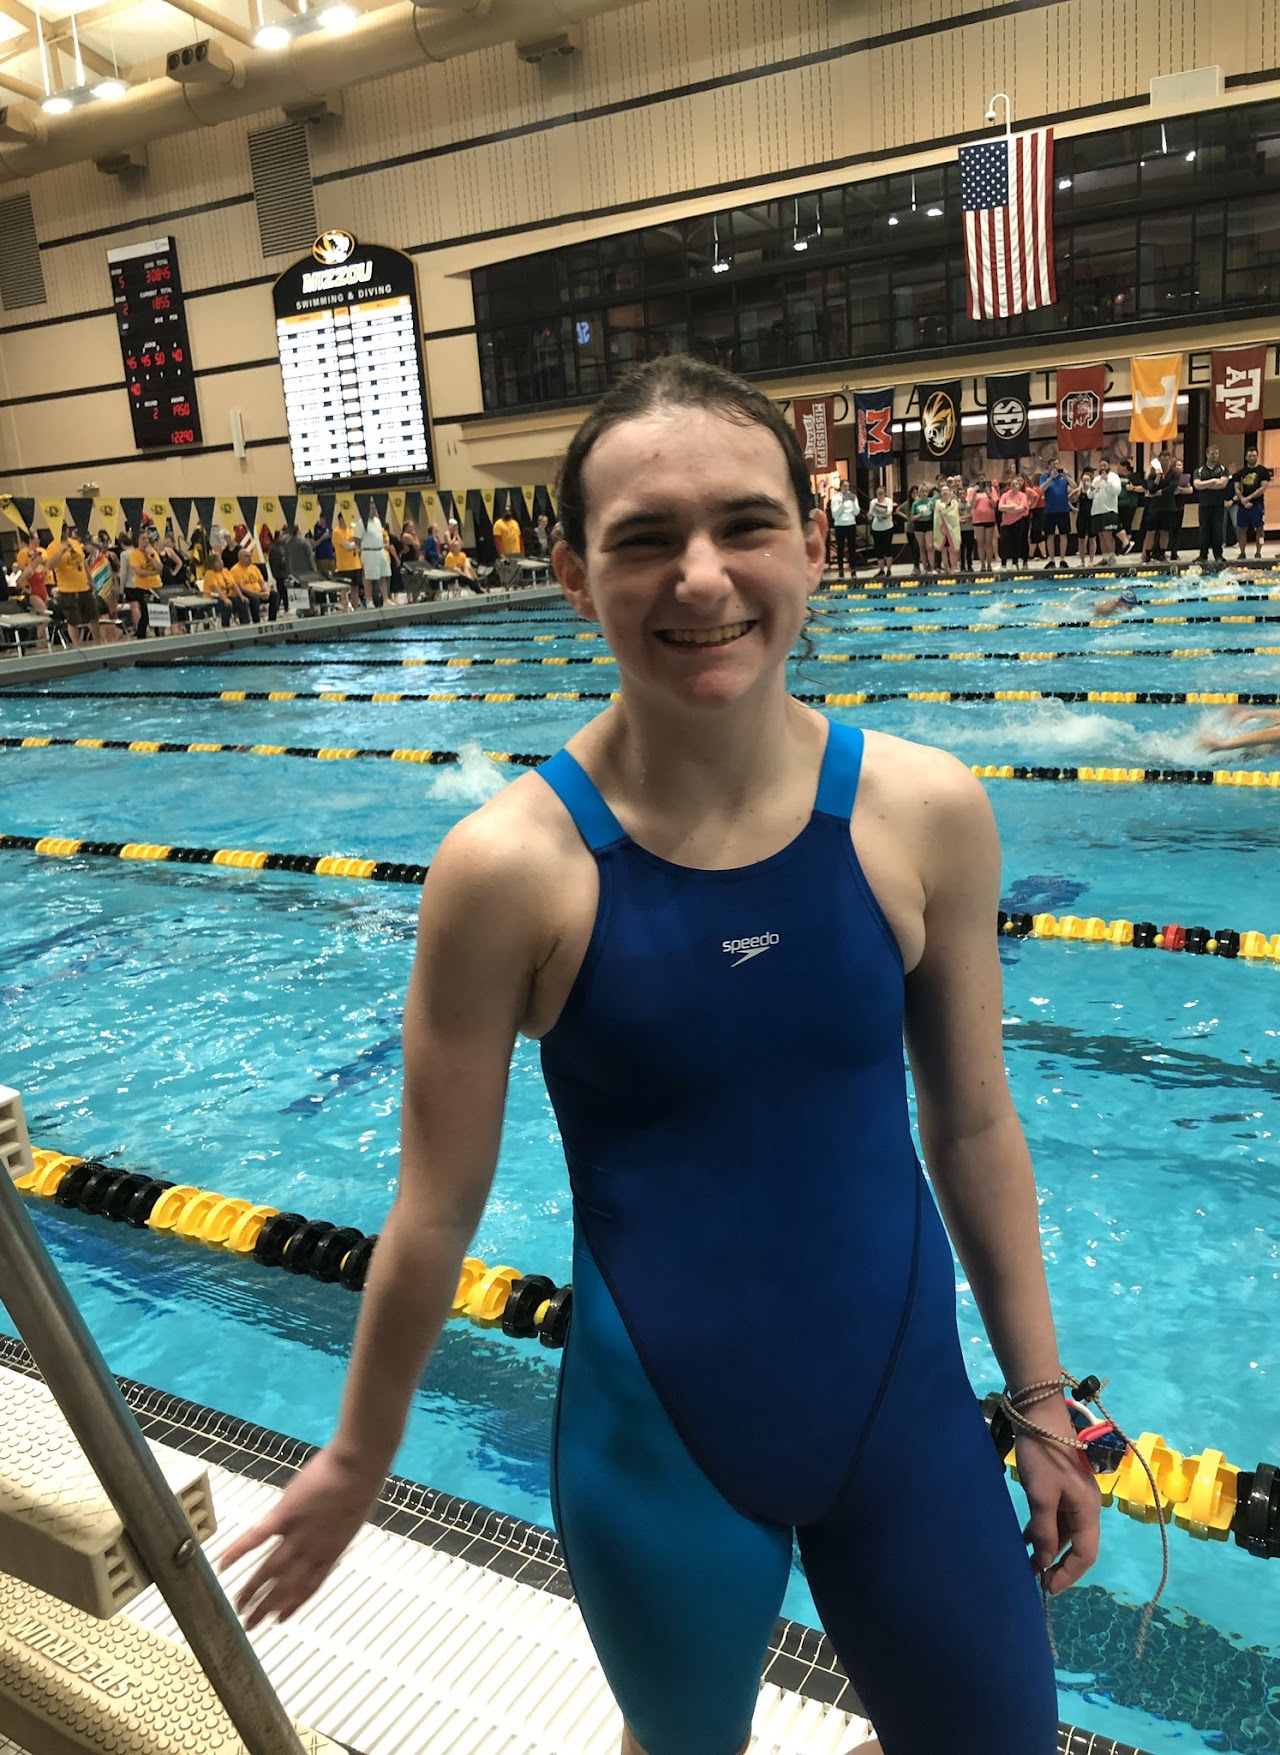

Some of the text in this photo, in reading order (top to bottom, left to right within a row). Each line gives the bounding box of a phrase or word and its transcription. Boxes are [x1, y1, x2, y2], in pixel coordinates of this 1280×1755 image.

[295, 284, 392, 310] SWIMMING & DIVING
[302, 261, 373, 294] MIZZOU
[814, 403, 827, 468] MISSISSIPPI
[866, 406, 892, 455] M
[722, 931, 780, 954] speedo
[8, 1616, 144, 1699] SPECTRUM
